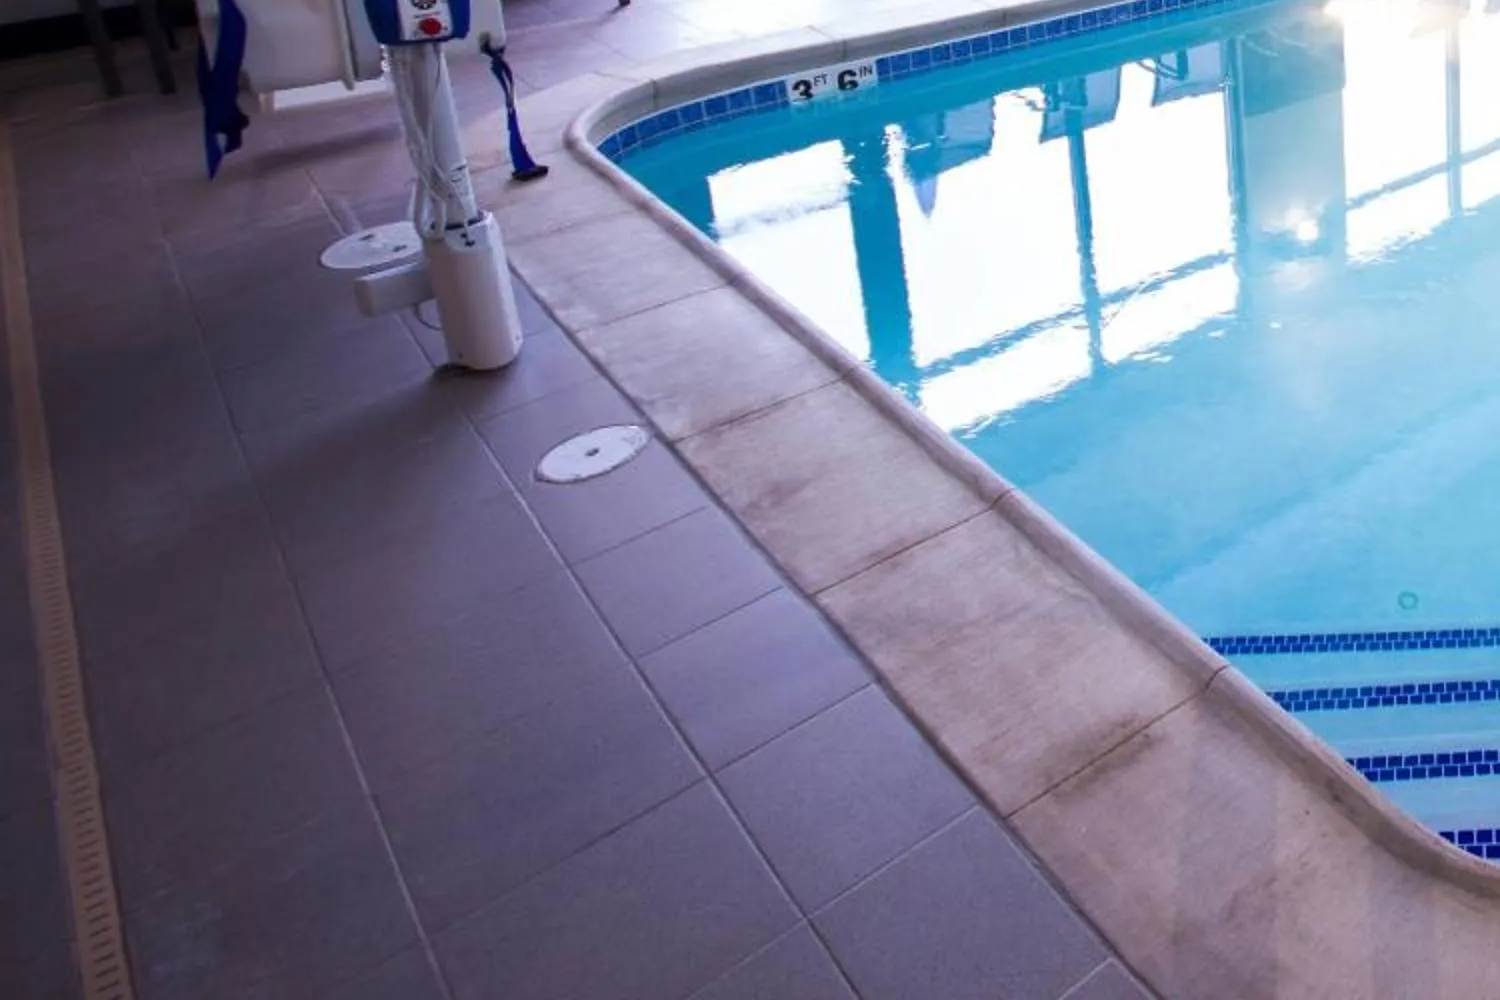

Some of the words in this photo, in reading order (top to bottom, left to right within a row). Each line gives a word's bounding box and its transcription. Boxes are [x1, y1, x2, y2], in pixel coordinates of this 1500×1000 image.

[792, 79, 813, 100] 3
[813, 73, 828, 87] FT
[837, 69, 859, 90] 6
[859, 63, 873, 77] IN
